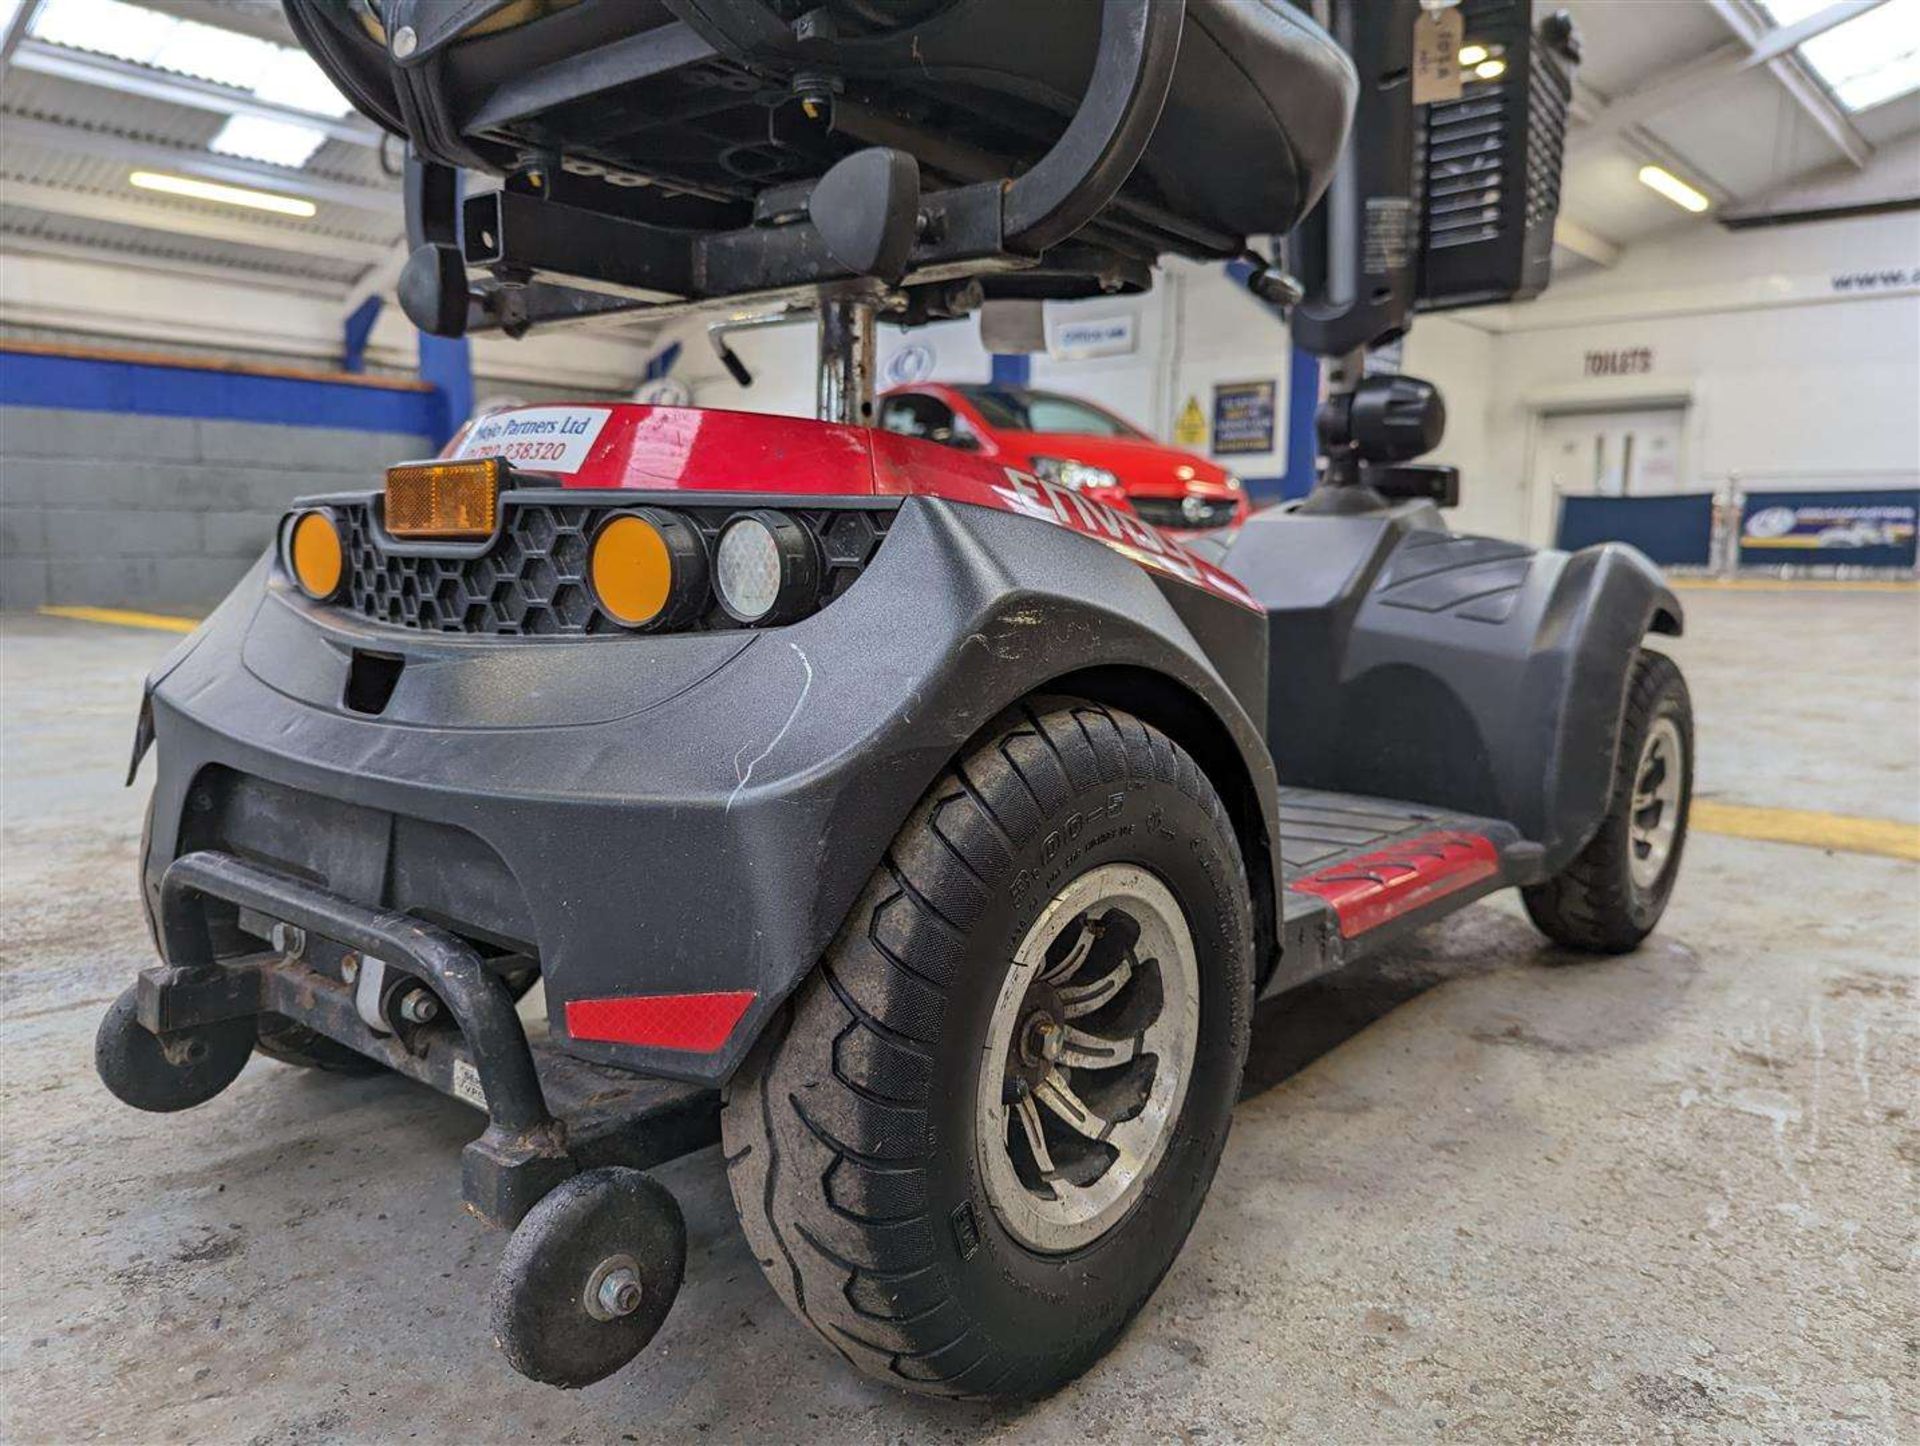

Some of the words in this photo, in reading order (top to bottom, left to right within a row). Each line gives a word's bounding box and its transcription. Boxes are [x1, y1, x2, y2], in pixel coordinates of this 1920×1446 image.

[1584, 348, 1652, 377] TOILETS
[503, 418, 558, 436] Partners
[560, 416, 591, 435] Ltd
[504, 442, 567, 461] 238320
